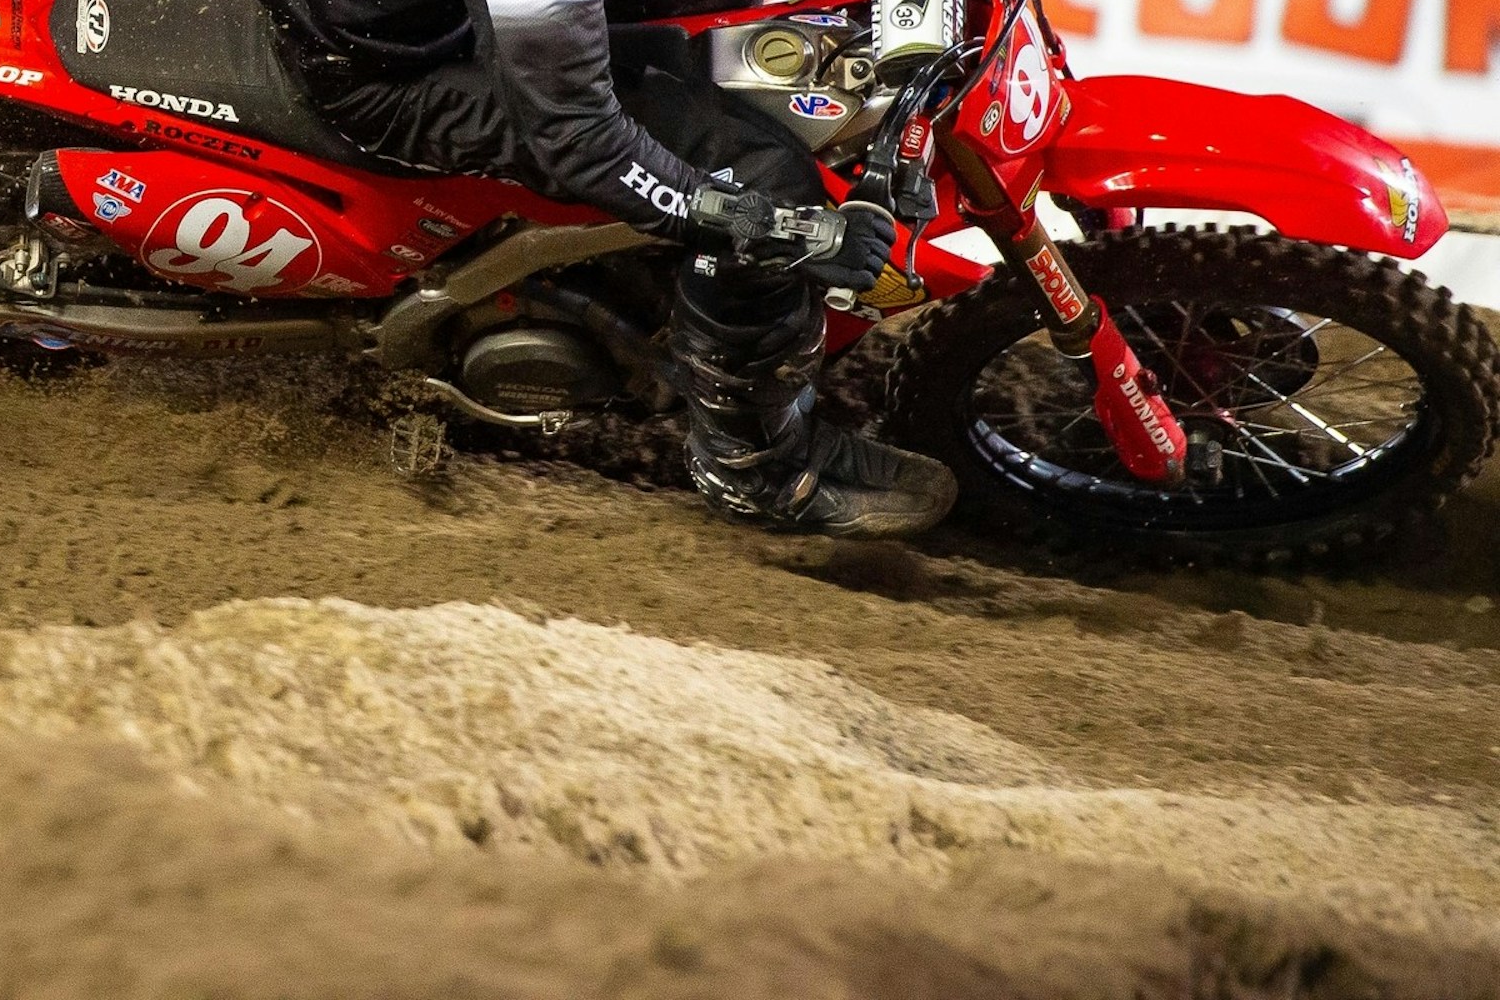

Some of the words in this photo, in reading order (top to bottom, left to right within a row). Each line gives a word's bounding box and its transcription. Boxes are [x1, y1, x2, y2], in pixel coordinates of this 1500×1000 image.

[895, 7, 915, 27] 36
[109, 84, 240, 123] HONDA
[795, 96, 829, 116] VP
[144, 119, 263, 161] ROCZEN
[100, 170, 145, 201] AMA
[619, 161, 693, 220] HON
[1401, 157, 1420, 243] HOA
[149, 197, 313, 292] 94
[1027, 247, 1083, 323] SHOWA
[1119, 377, 1176, 455] DUNLOP
